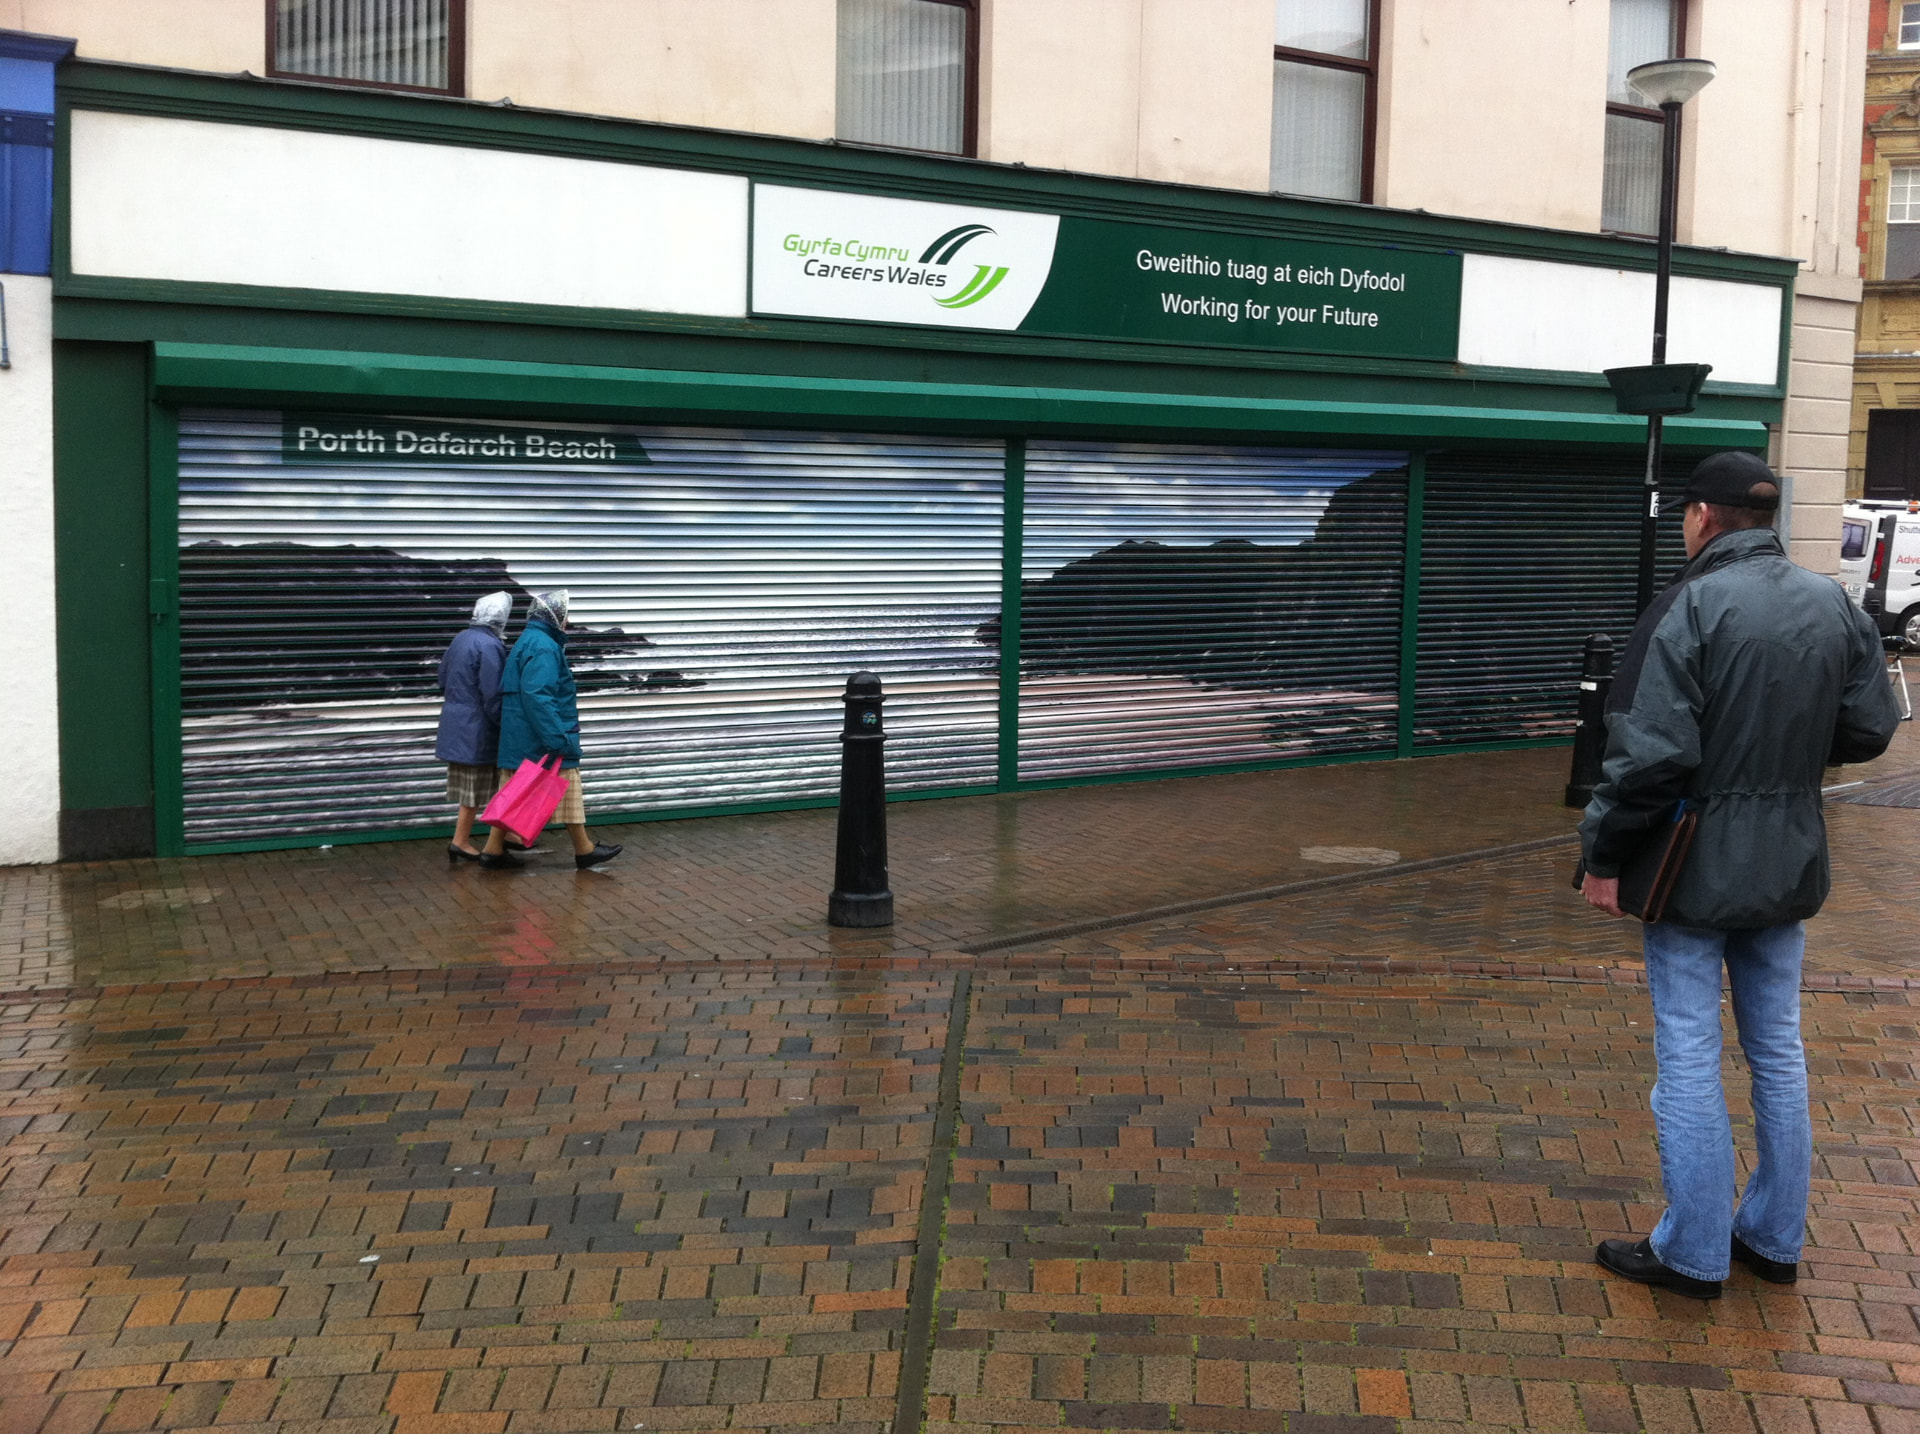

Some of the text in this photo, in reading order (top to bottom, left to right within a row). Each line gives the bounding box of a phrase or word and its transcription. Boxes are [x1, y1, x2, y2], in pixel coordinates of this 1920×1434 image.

[783, 233, 910, 262] Gyrfa Cymru
[803, 258, 948, 288] Careers Wales
[1136, 249, 1406, 293] Gweithio tuag at eich Dyfodol
[1161, 292, 1379, 328] Working for your Future
[297, 426, 616, 460] Porth Dafarch Beach
